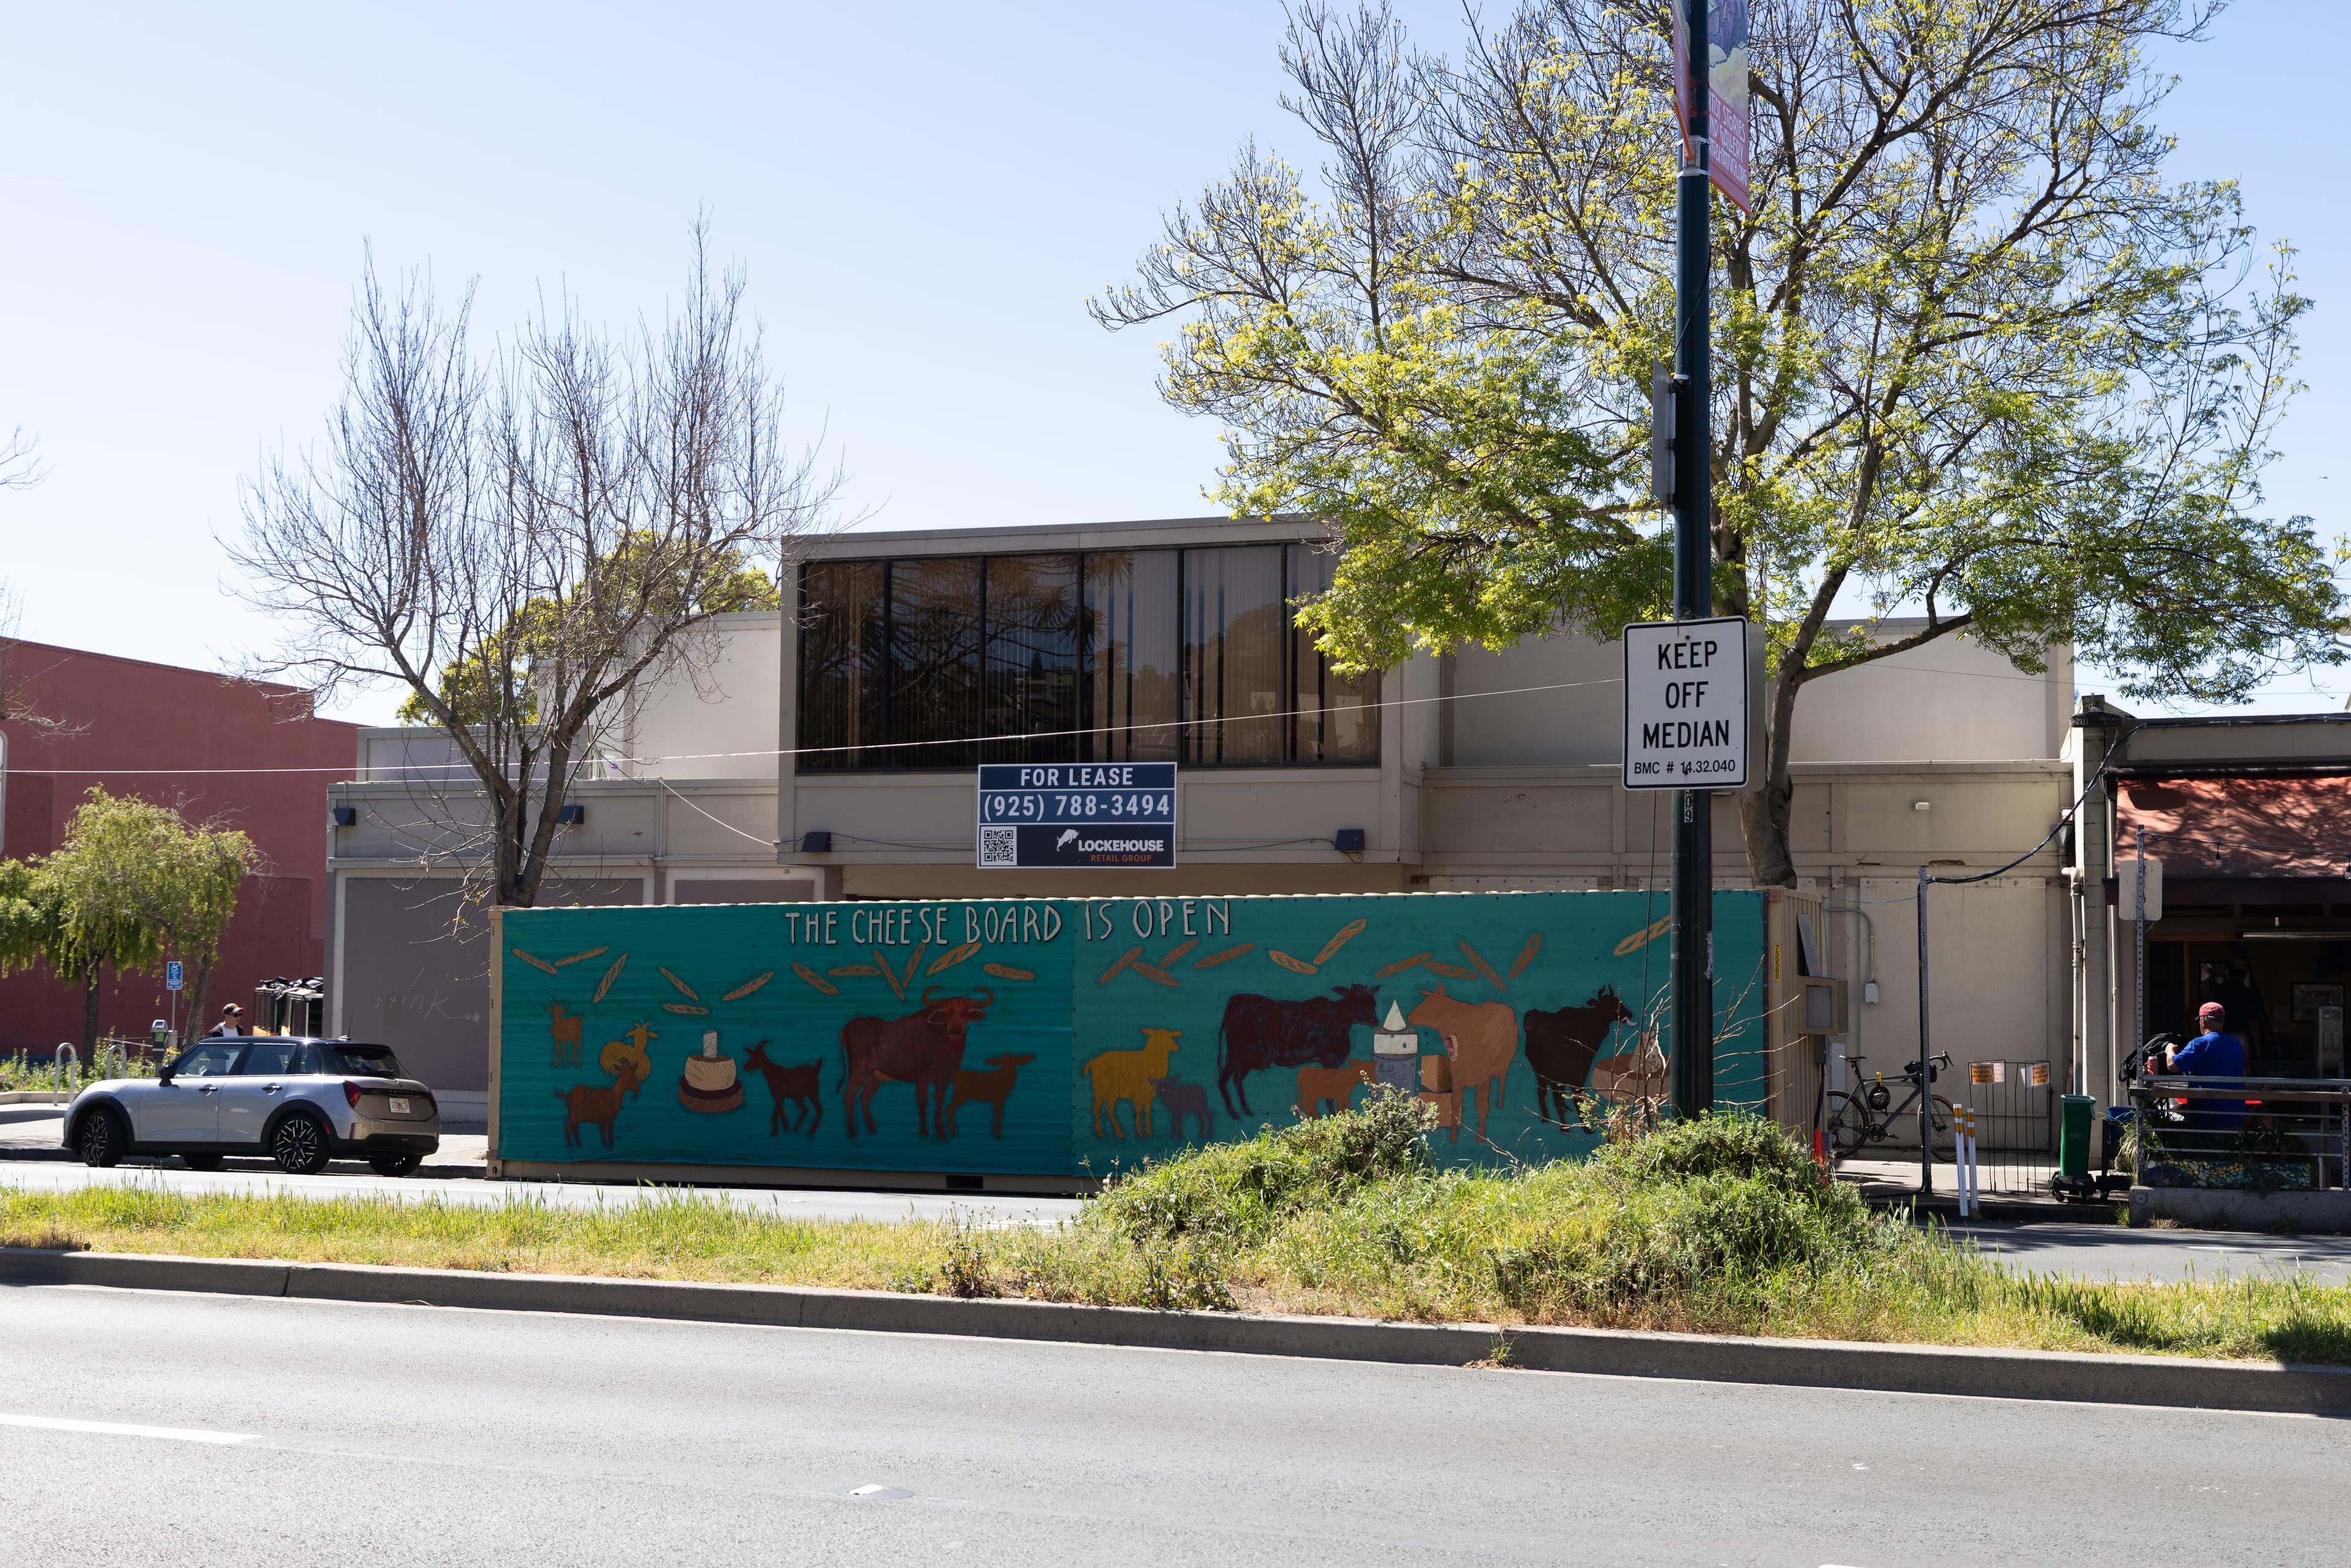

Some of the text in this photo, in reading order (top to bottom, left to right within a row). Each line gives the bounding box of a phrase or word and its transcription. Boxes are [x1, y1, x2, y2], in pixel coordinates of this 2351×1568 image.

[1709, 114, 1744, 163] ND GALLERY
[1723, 105, 1745, 143] STORIES
[1658, 640, 1718, 670] KEEP
[1665, 680, 1709, 709] OFF
[1643, 719, 1730, 749] MEDIAN
[1021, 767, 1133, 786] FOR LEASE
[1634, 759, 1736, 775] BMC # 14.32.040
[984, 793, 1169, 822] (925) 788-3494
[1078, 839, 1164, 852] LOCKEHOUSE
[785, 900, 1230, 945] THE CHEESE BOARD IS OPEN
